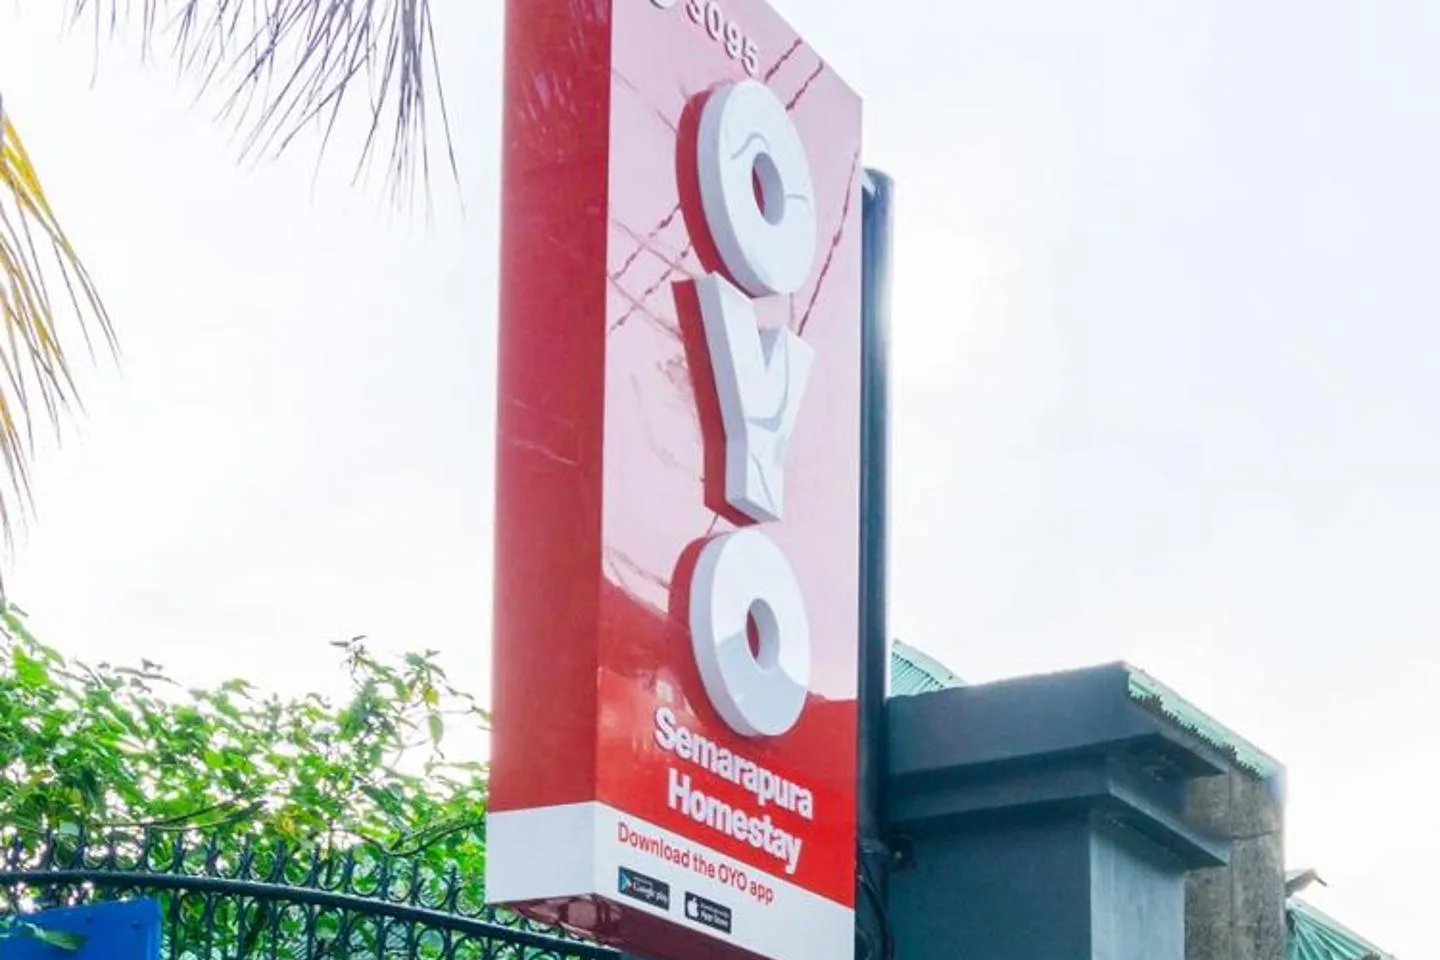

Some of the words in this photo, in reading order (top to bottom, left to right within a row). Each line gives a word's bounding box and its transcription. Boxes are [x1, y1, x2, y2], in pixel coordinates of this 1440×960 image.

[689, 80, 816, 736] OYO
[655, 706, 814, 820] Semarapura
[617, 821, 690, 867] Download
[692, 851, 715, 879] the
[718, 863, 748, 891] OYO
[750, 880, 774, 905] app
[667, 768, 803, 873] Homestay
